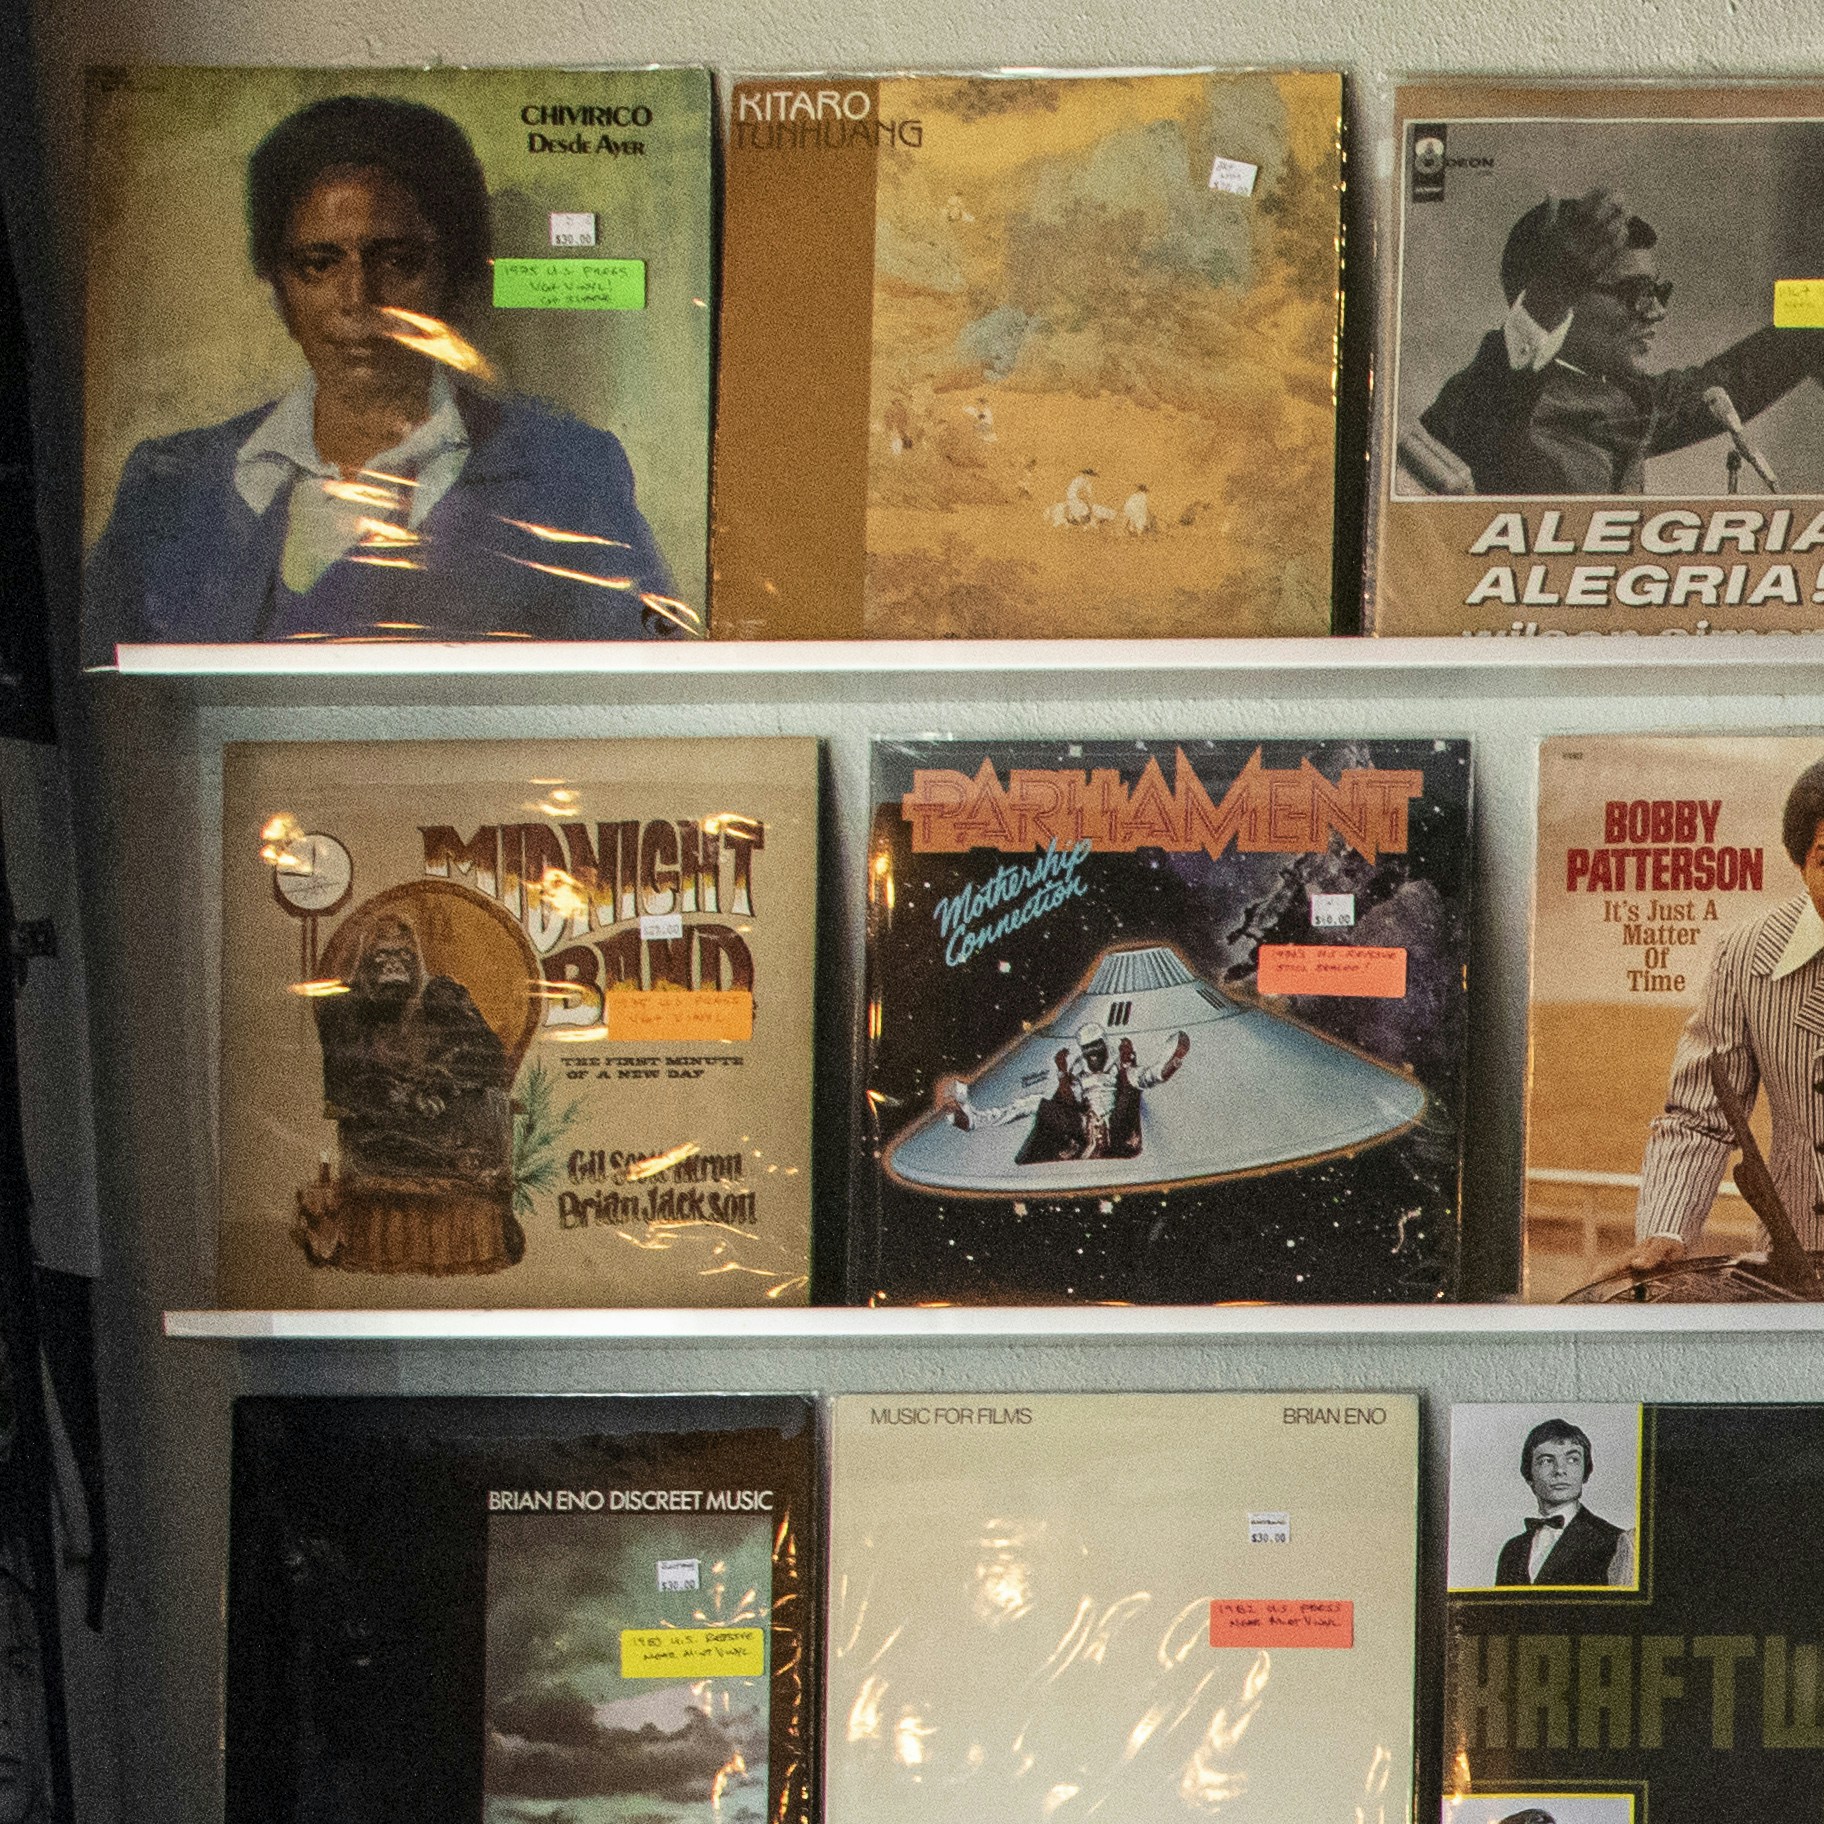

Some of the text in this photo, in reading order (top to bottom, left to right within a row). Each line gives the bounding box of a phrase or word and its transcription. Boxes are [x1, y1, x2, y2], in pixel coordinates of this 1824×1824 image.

[521, 105, 653, 128] CHIVIRICO
[739, 91, 871, 121] KITARO
[902, 745, 1425, 866] PARLIAMENT
[1604, 800, 1723, 845] BOBBY
[1566, 847, 1763, 893] PATTERSON
[1603, 900, 1719, 923] It's Just A
[1622, 924, 1701, 946] Matter
[1644, 948, 1670, 969] Of
[1626, 970, 1687, 992] Time
[561, 1057, 744, 1068] THE FIRST MINUTE
[871, 1407, 1033, 1425] MUSIC FOR FILMS
[1282, 1406, 1388, 1425] BRIAN ENO
[489, 1489, 774, 1512] BRIAN ENO DISCREET MUSIC
[1251, 1532, 1286, 1544] $30.00
[661, 1579, 696, 1591] $30.00
